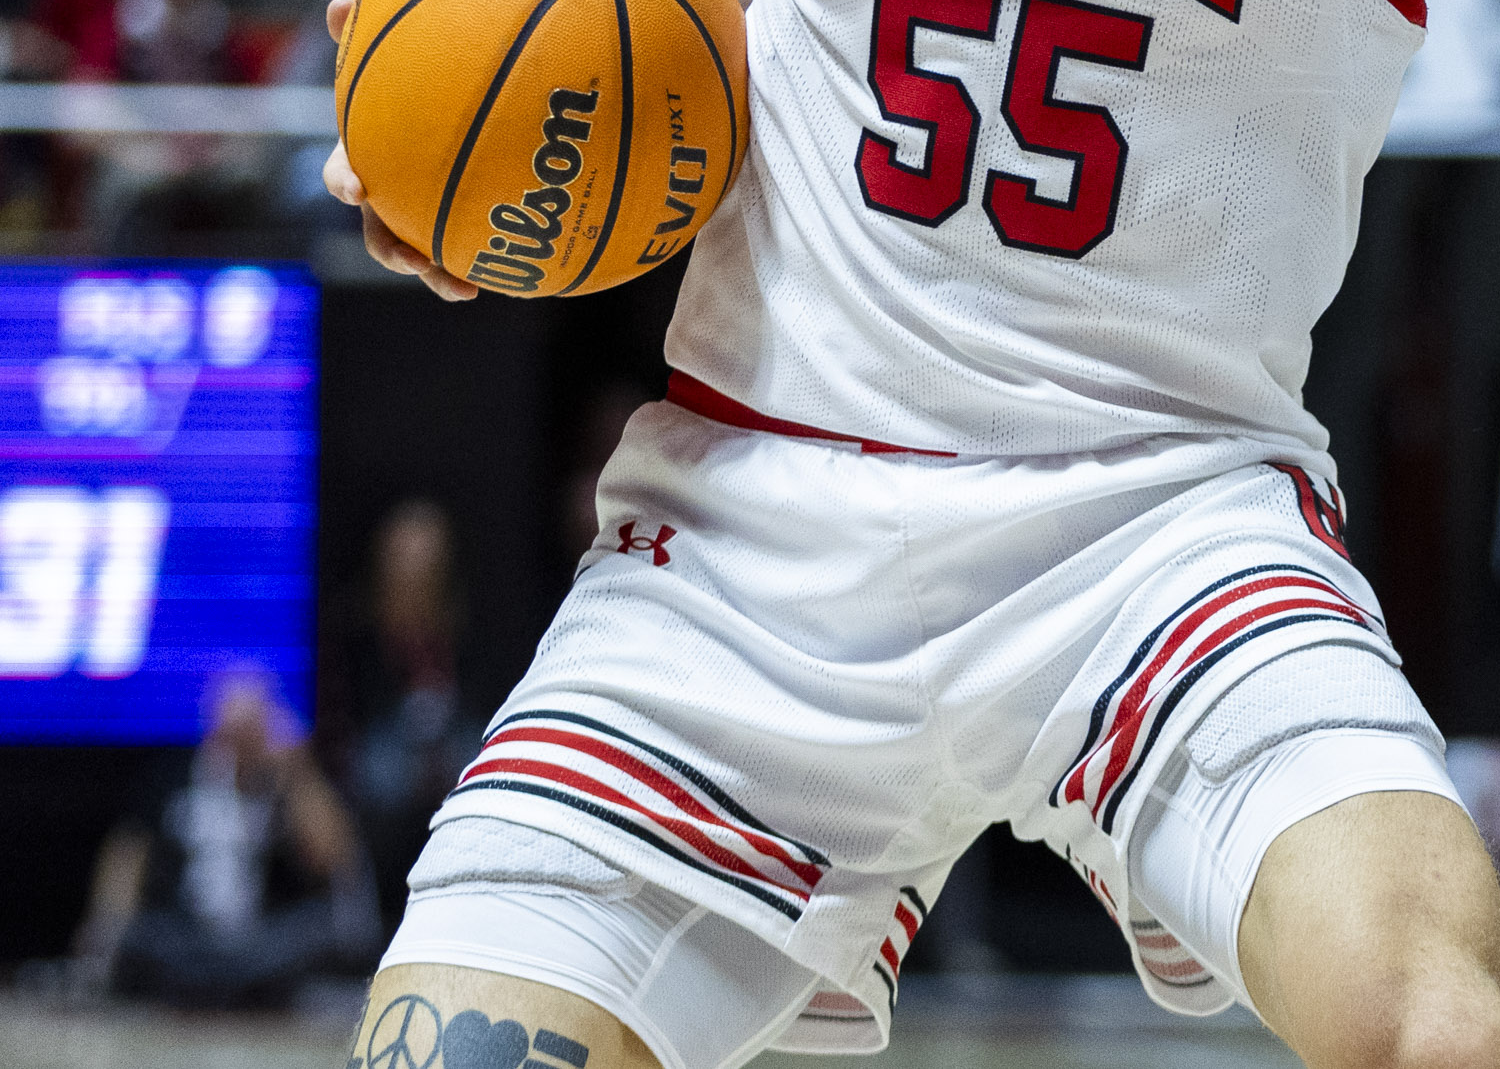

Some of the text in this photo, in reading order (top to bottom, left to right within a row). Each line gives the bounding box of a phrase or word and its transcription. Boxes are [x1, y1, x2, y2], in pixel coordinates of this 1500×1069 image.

[467, 88, 599, 293] Wilson
[573, 202, 588, 233] GAME
[583, 167, 598, 199] BALL
[636, 88, 708, 265] EVO NXT
